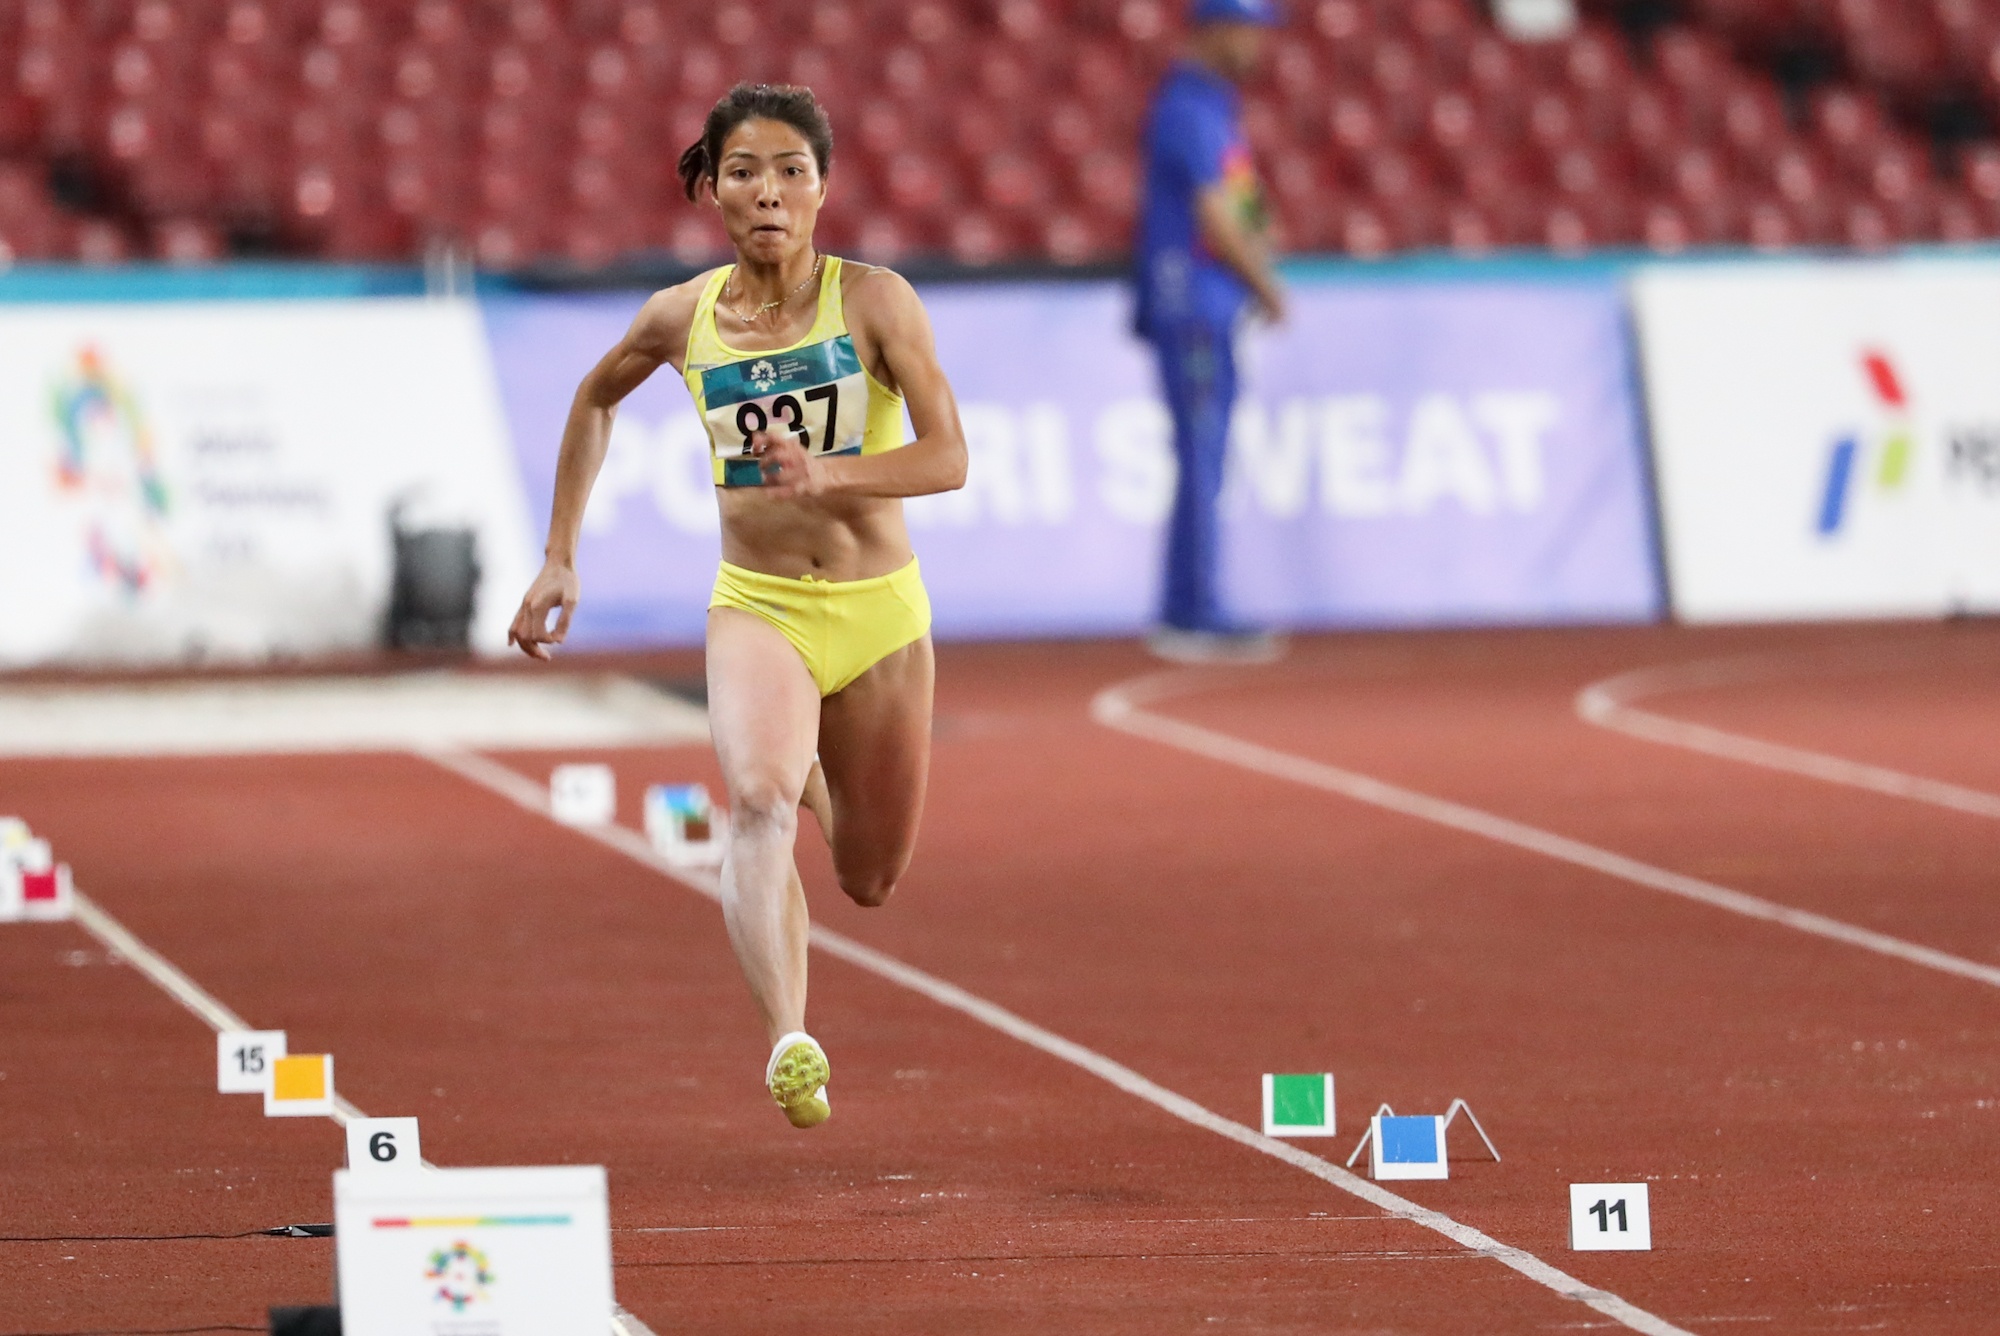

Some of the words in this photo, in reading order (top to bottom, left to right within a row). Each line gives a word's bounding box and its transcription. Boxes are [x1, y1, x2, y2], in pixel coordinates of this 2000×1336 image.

[736, 383, 839, 456] 837
[234, 1046, 265, 1074] 15
[369, 1131, 398, 1163] 6
[1589, 1199, 1628, 1232] 11
